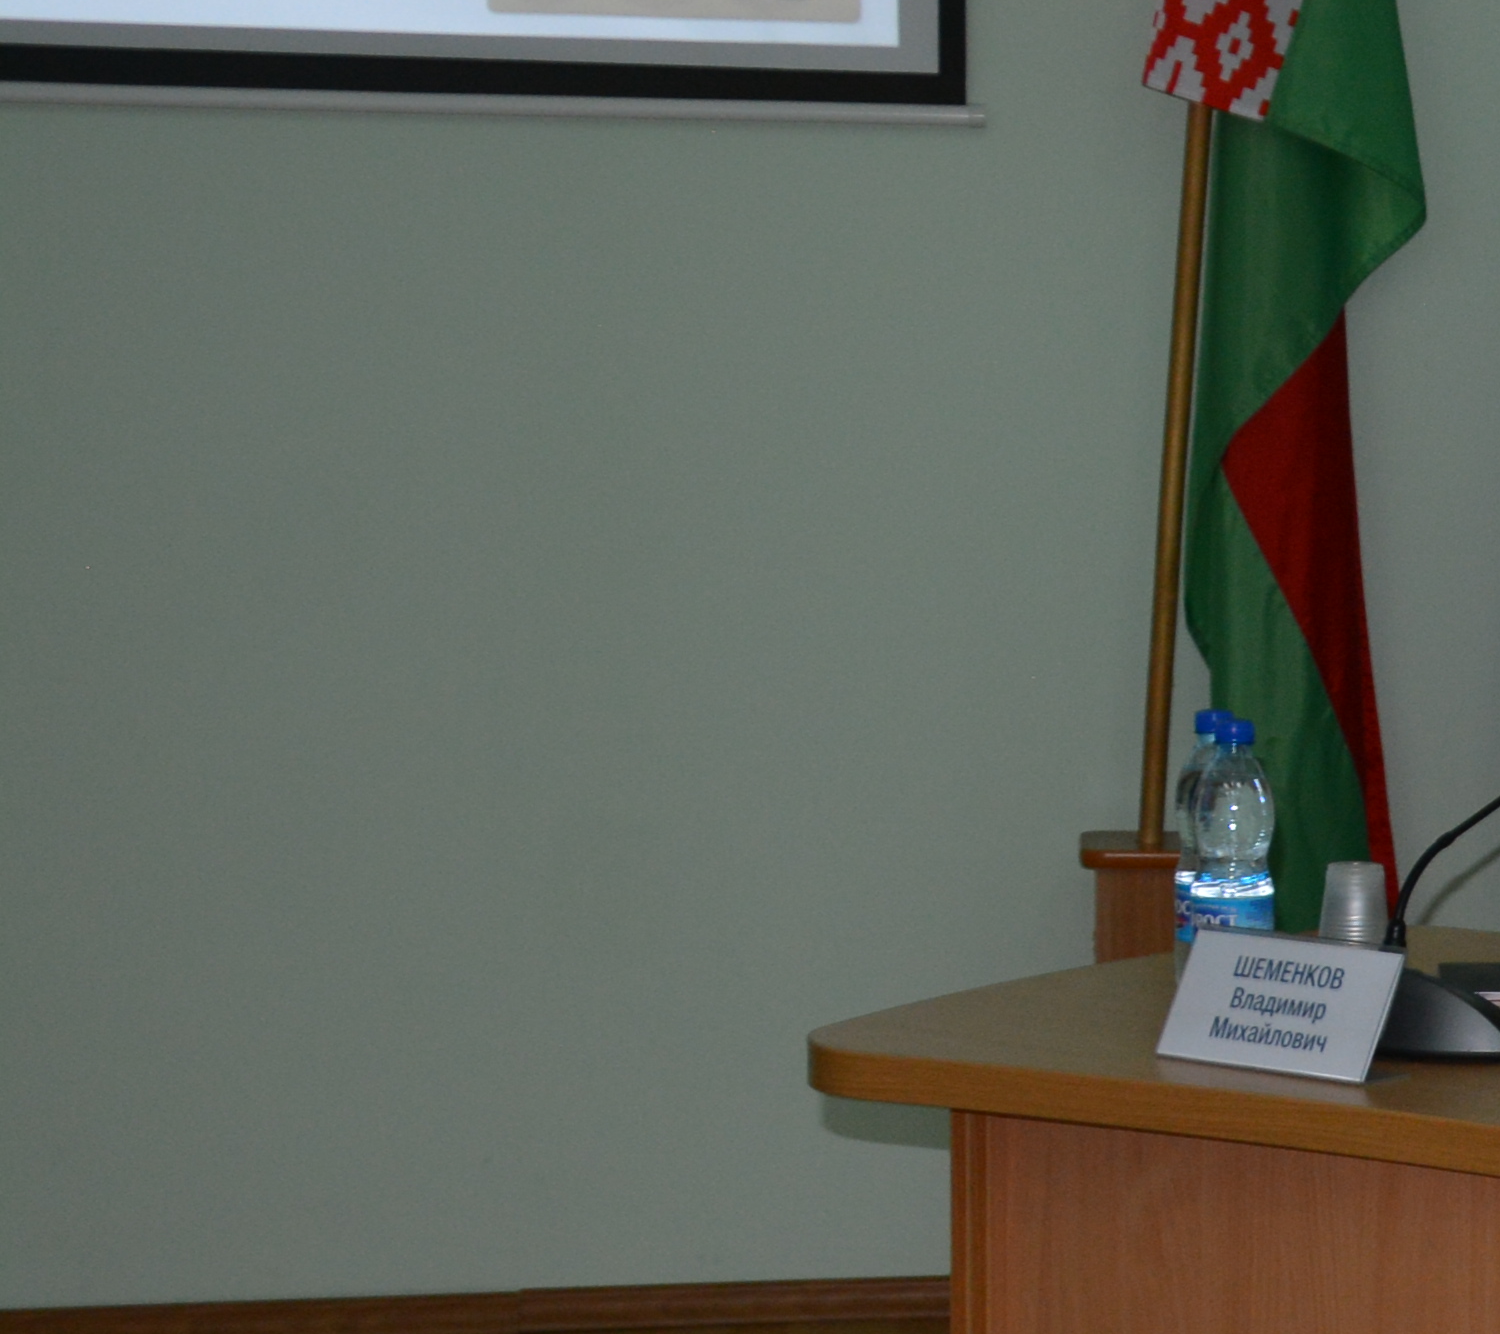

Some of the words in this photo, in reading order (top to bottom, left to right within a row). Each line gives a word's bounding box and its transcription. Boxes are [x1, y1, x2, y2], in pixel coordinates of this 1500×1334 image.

[1233, 955, 1345, 989] ШЕМЕНКОВ
[1230, 987, 1326, 1023] Владимир
[1209, 1016, 1328, 1052] Михайлович
